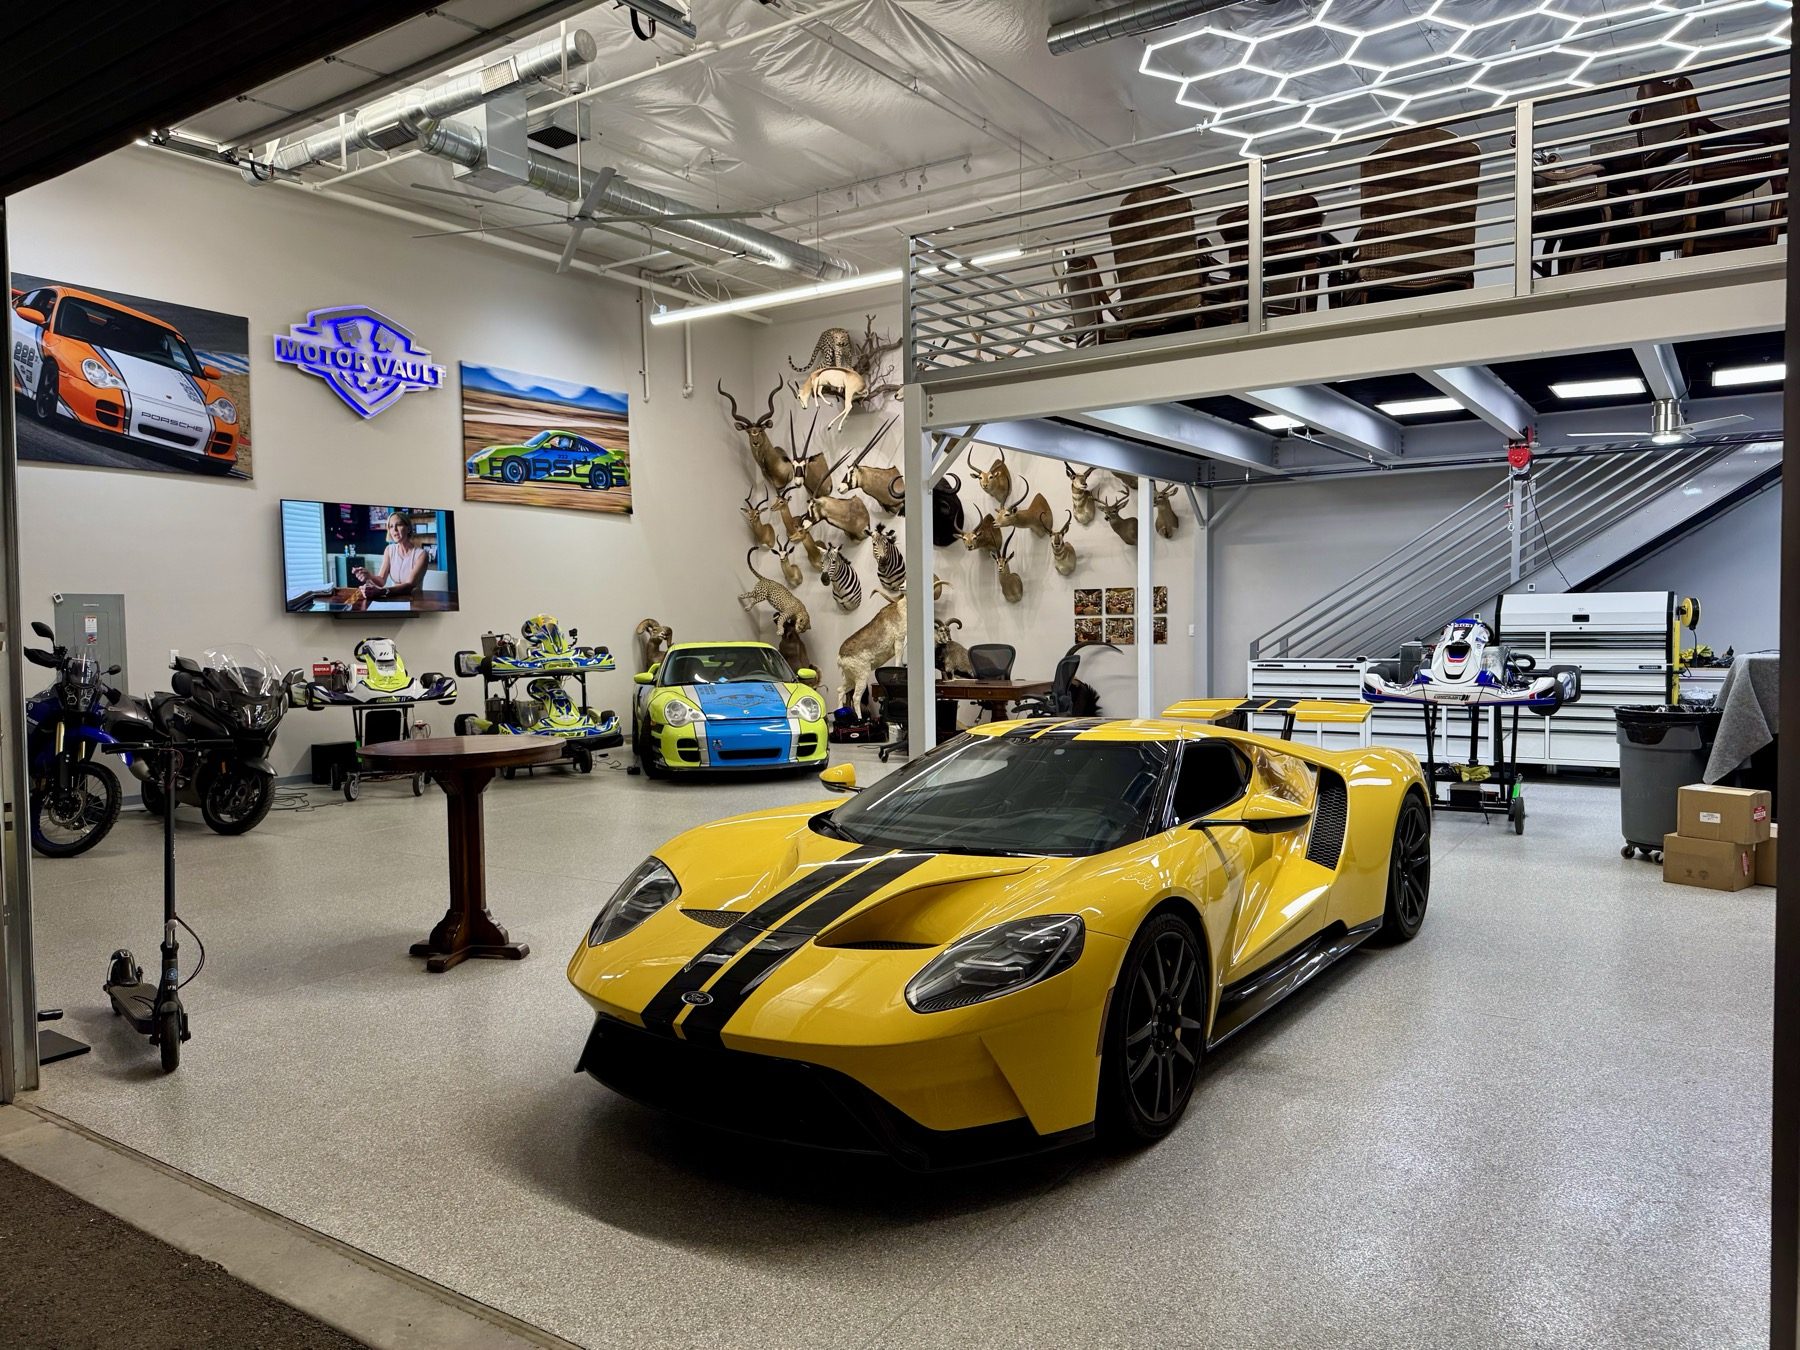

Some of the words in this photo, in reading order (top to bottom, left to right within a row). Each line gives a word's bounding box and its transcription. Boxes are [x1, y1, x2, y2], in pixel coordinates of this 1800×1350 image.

[279, 338, 371, 372] MOTOR
[375, 355, 446, 386] VAULT
[141, 411, 204, 433] PORSCHE
